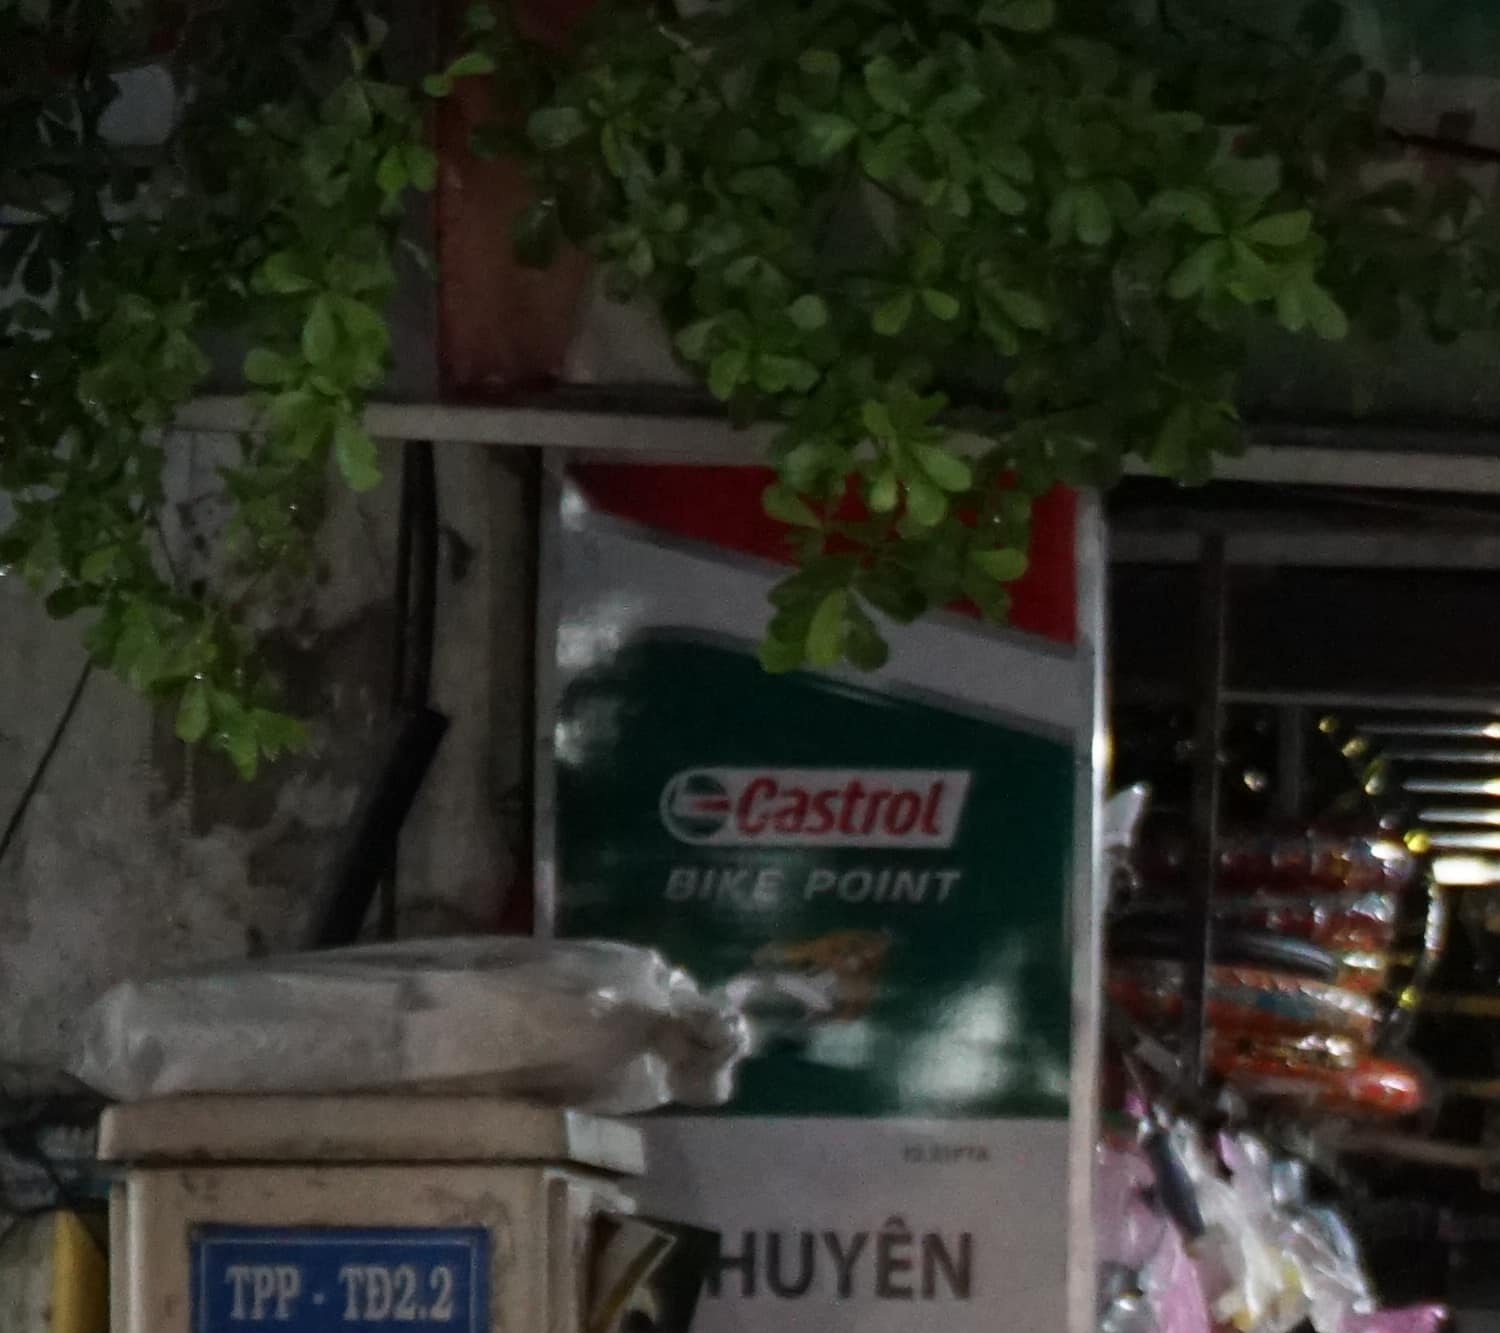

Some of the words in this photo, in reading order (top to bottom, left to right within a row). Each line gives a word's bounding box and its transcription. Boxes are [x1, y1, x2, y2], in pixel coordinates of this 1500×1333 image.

[735, 775, 947, 838] Castrol
[664, 868, 782, 900] BIKE
[803, 868, 963, 901] POINT
[703, 1215, 973, 1300] HUYÊN
[225, 1264, 300, 1321] TPP
